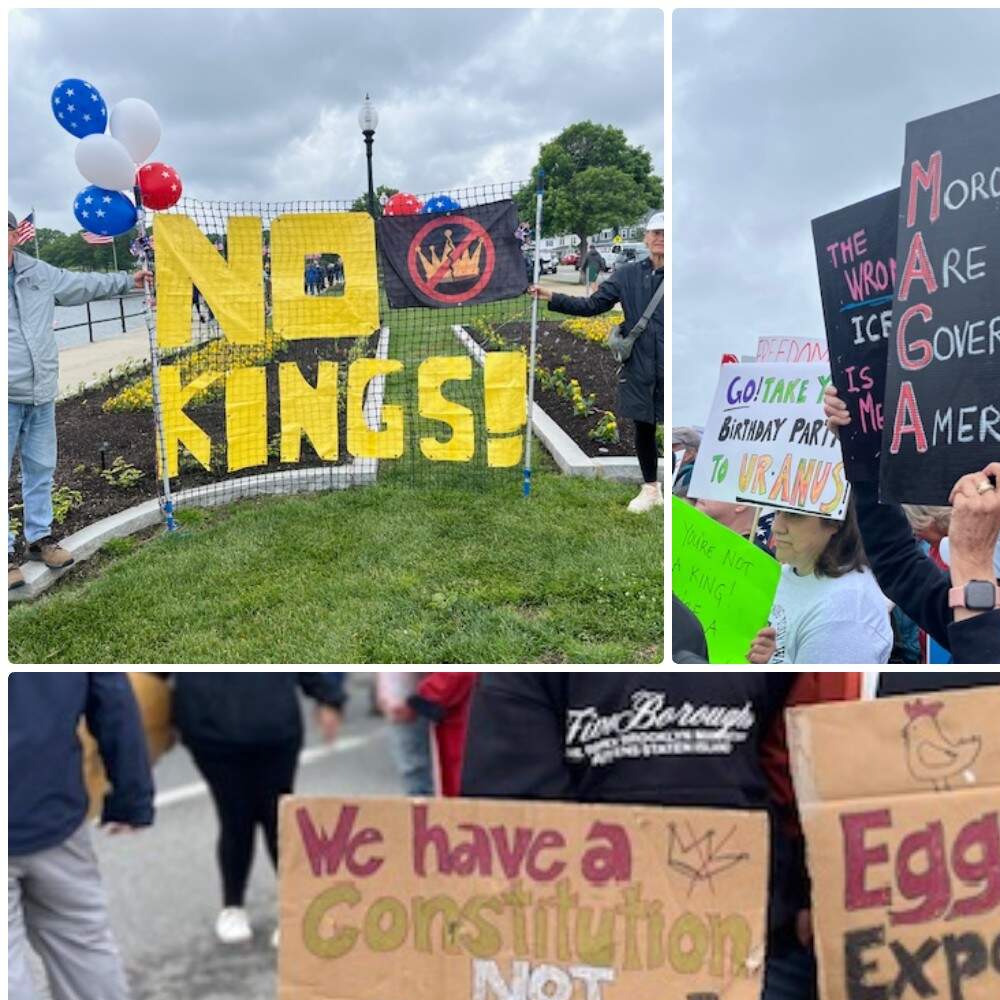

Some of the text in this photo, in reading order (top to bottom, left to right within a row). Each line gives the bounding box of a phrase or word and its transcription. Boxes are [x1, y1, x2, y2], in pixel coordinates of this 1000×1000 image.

[826, 229, 867, 269] THE
[900, 232, 986, 301] ARE
[153, 211, 379, 348] NO
[851, 309, 893, 345] ICE
[761, 376, 809, 404] TAKE
[845, 366, 874, 393] IS
[158, 351, 527, 480] KINGS!
[711, 454, 729, 484] TO
[722, 549, 755, 577] NOT
[295, 803, 633, 887] We have a
[302, 877, 756, 977] Constitution
